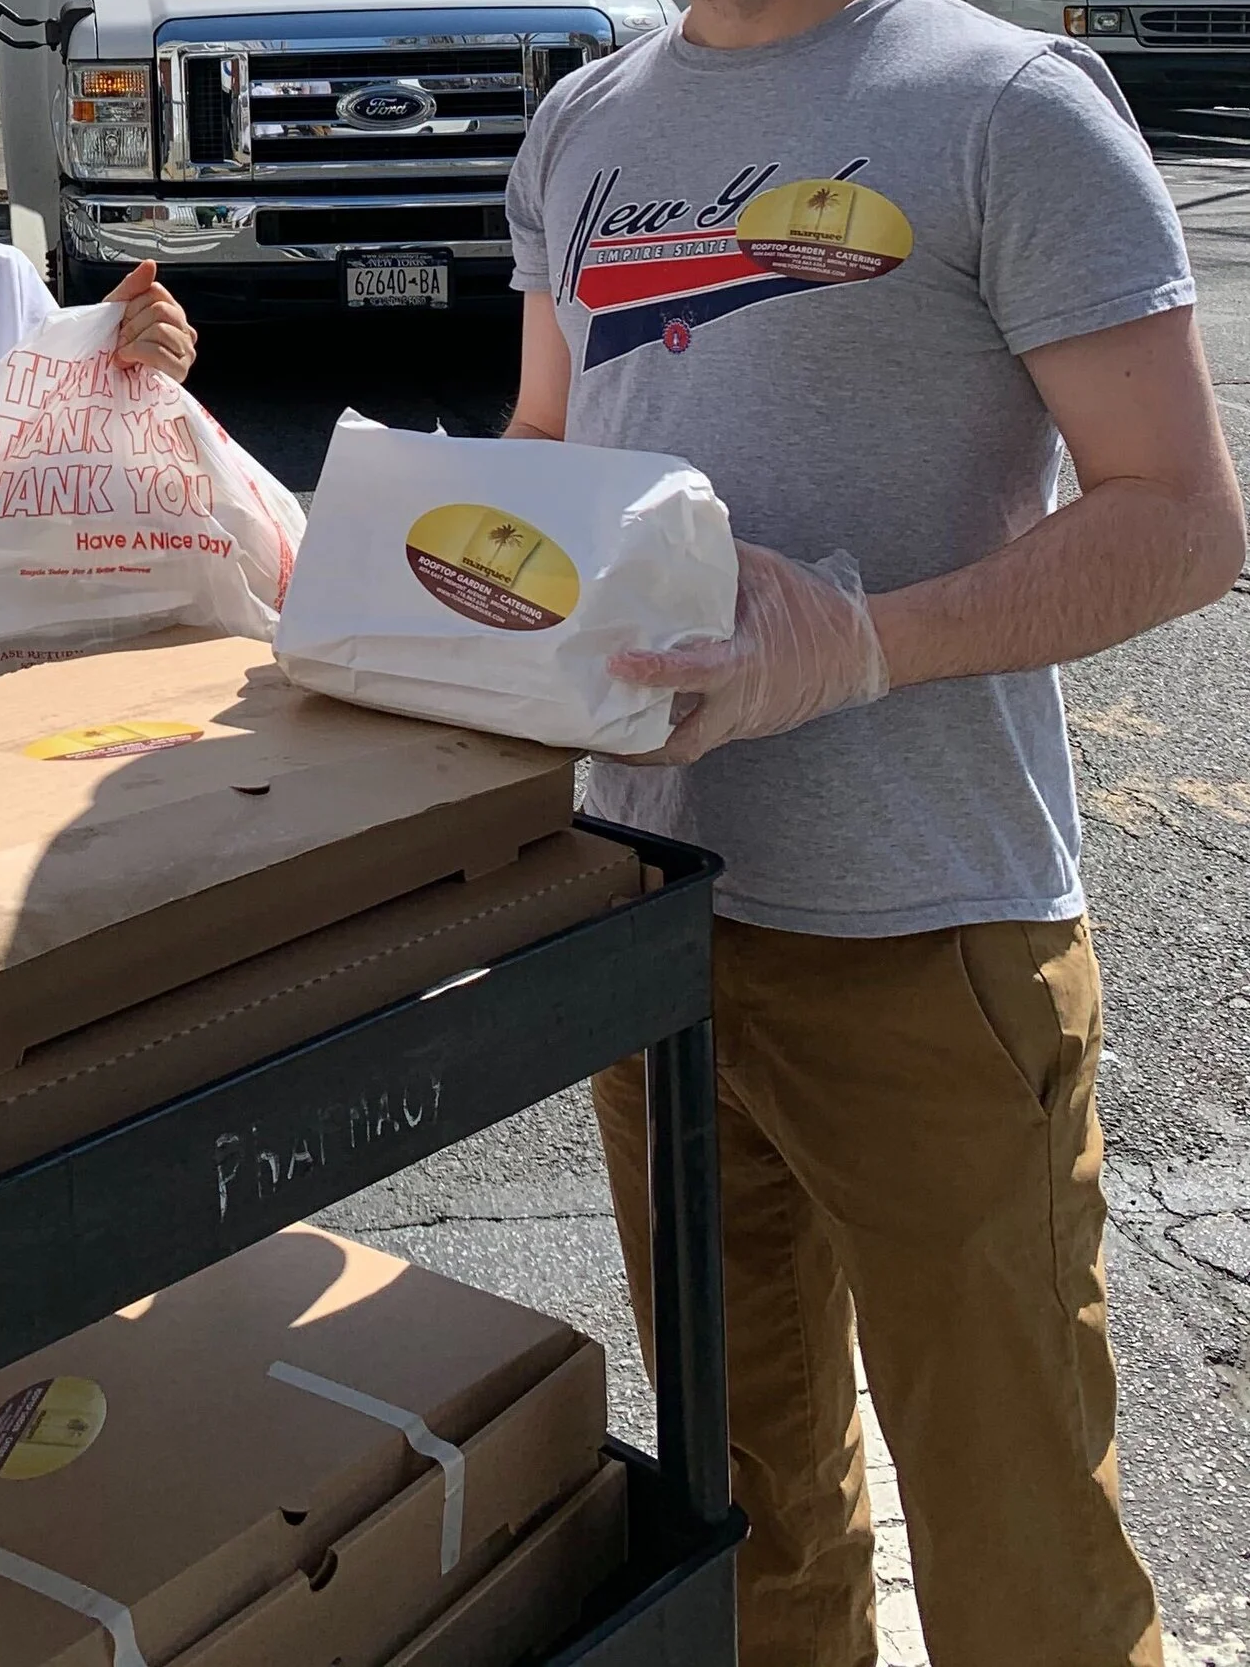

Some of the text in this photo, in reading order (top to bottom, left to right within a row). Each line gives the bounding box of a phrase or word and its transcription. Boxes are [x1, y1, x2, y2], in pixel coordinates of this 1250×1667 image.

[366, 97, 409, 115] Ford
[556, 167, 691, 306] New
[597, 239, 728, 264] EMPIRE STATE
[751, 243, 787, 251] ROOFTOP
[789, 245, 826, 255] GARDEN
[836, 251, 882, 266] CATERING
[125, 464, 213, 517] YOU
[76, 532, 233, 558] Have A Nice Day
[462, 556, 512, 584] marquee
[418, 556, 457, 578] ROOFTOP
[457, 574, 492, 595] GARDEN
[499, 594, 543, 620] CATERING
